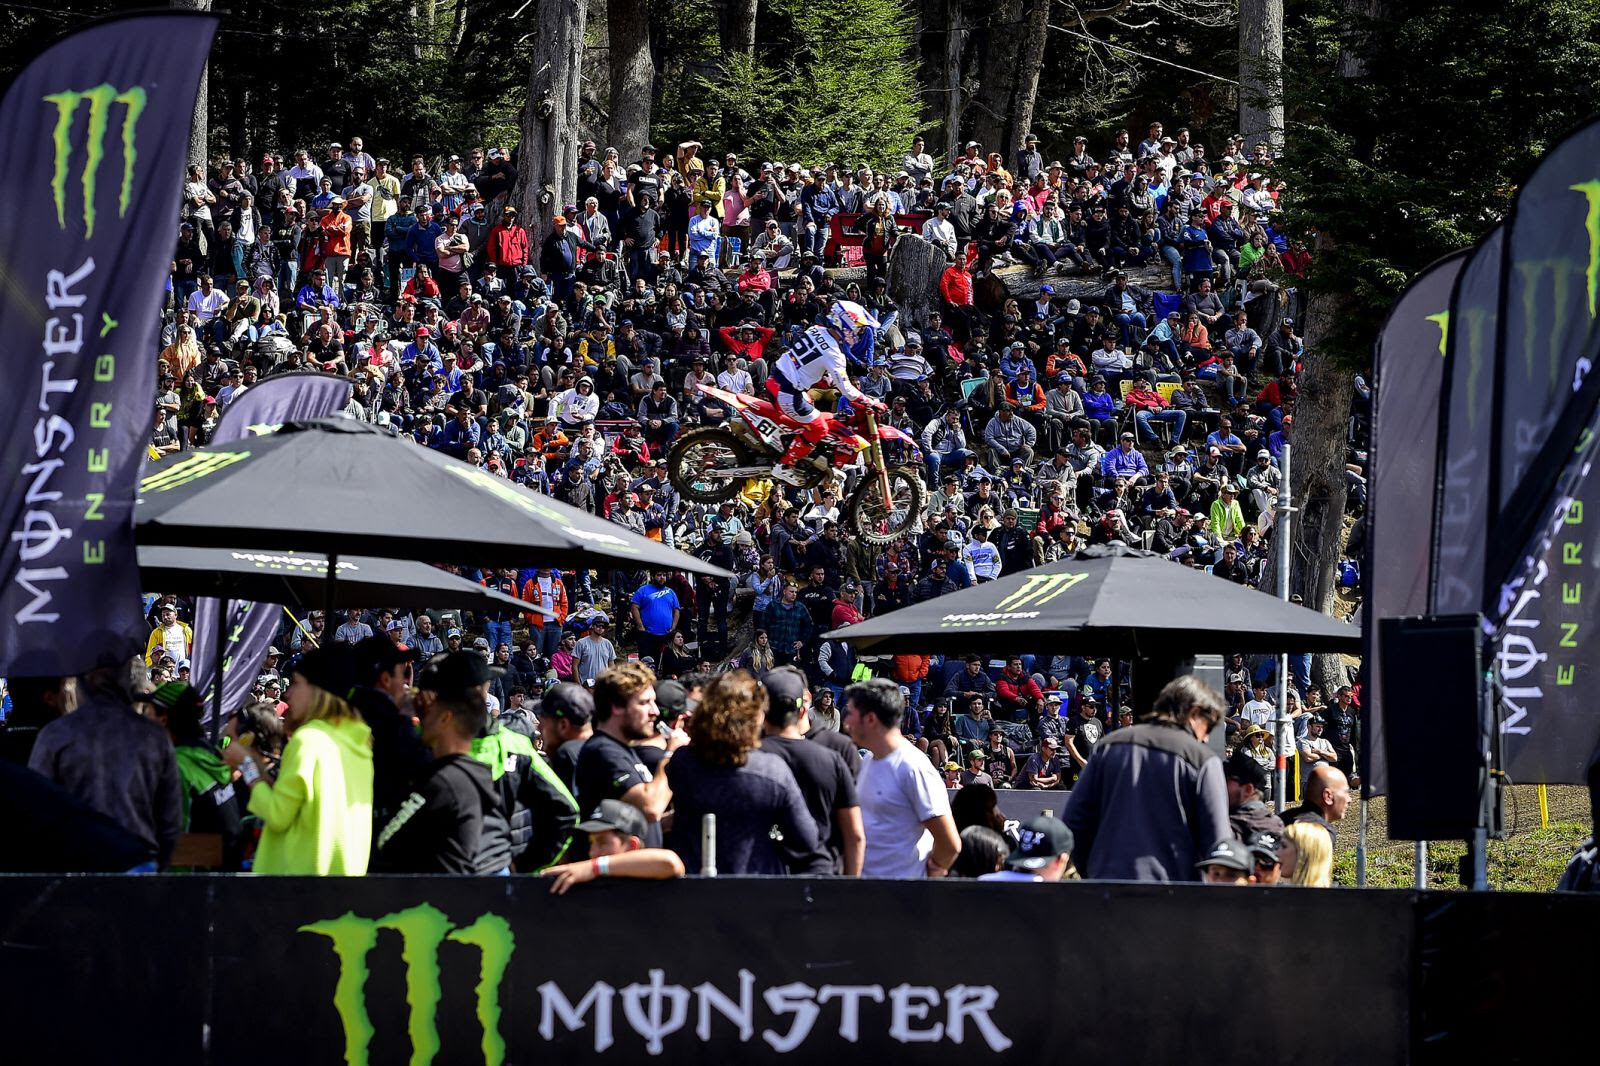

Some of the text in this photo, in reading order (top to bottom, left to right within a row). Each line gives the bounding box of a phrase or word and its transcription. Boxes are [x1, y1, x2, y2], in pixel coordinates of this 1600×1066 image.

[791, 332, 824, 366] 61
[11, 256, 96, 626] MONSTER
[82, 311, 120, 565] ENERGY
[757, 418, 778, 438] 61
[536, 968, 1013, 1055] MONSTER
